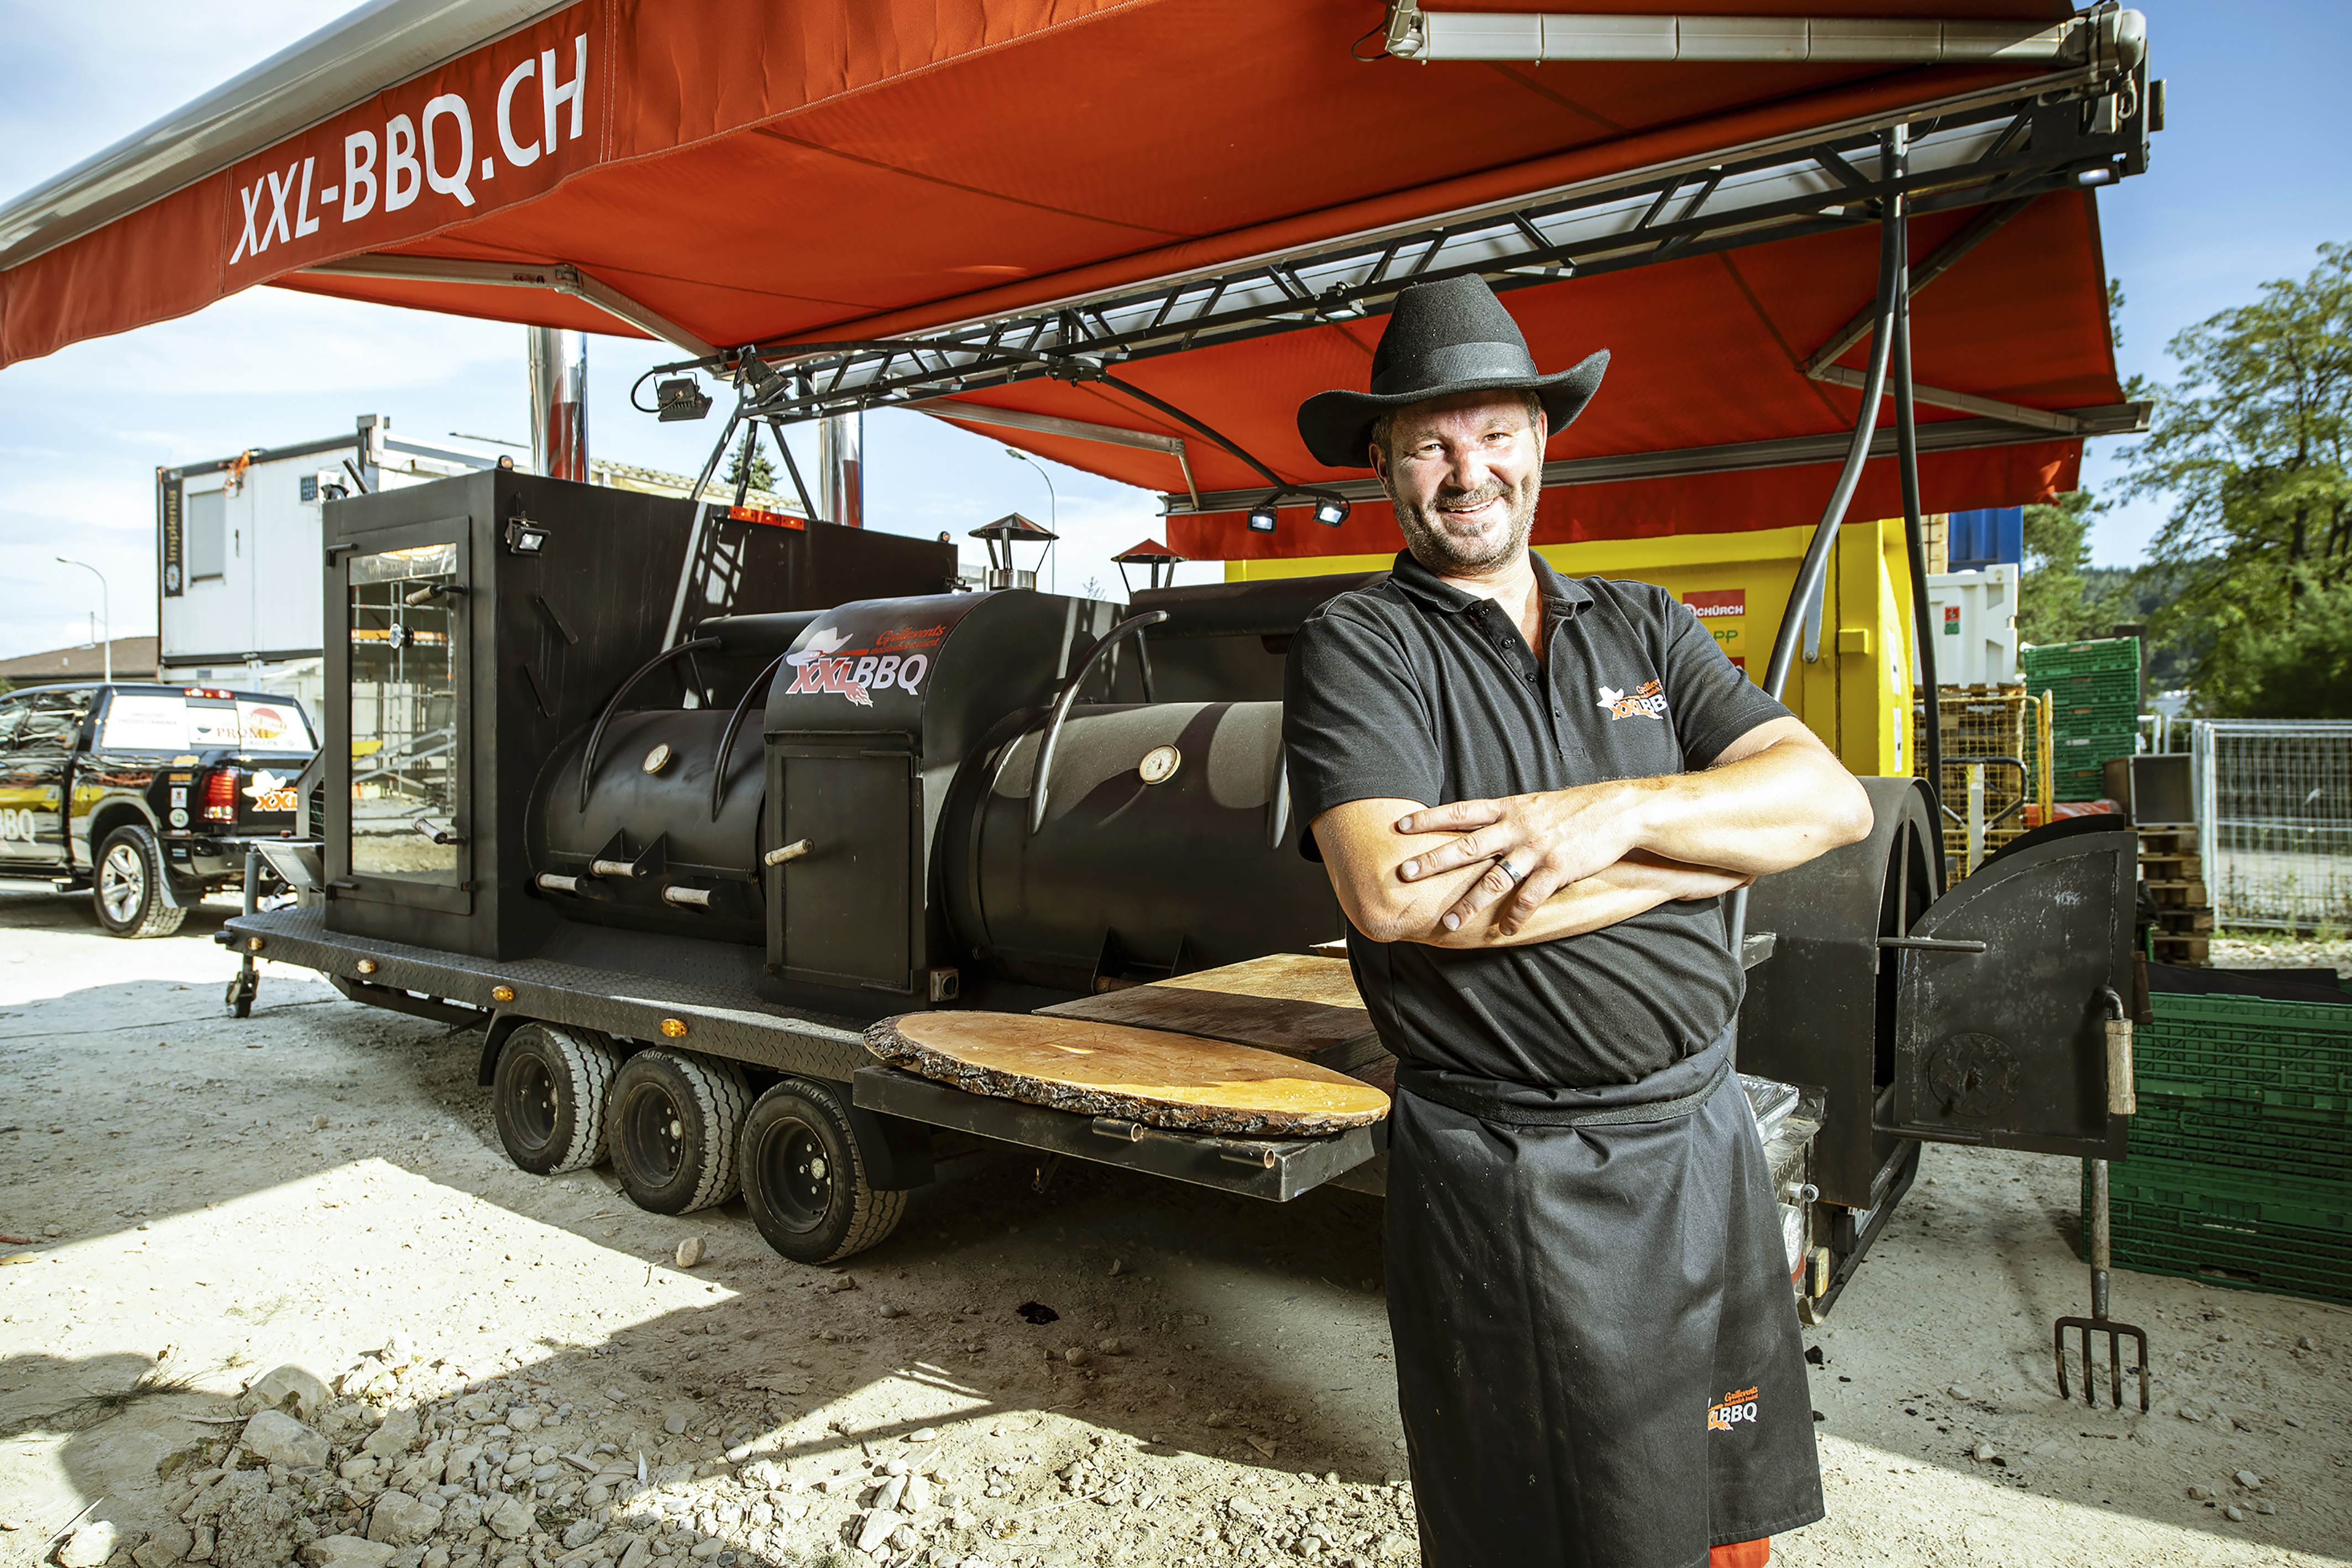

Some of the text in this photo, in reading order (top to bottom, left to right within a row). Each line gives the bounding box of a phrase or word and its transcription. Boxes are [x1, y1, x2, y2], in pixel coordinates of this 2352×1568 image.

[229, 33, 587, 265] XXL-BBQ.CH
[876, 624, 947, 646] Grillevents
[1636, 678, 1661, 694] Grillev
